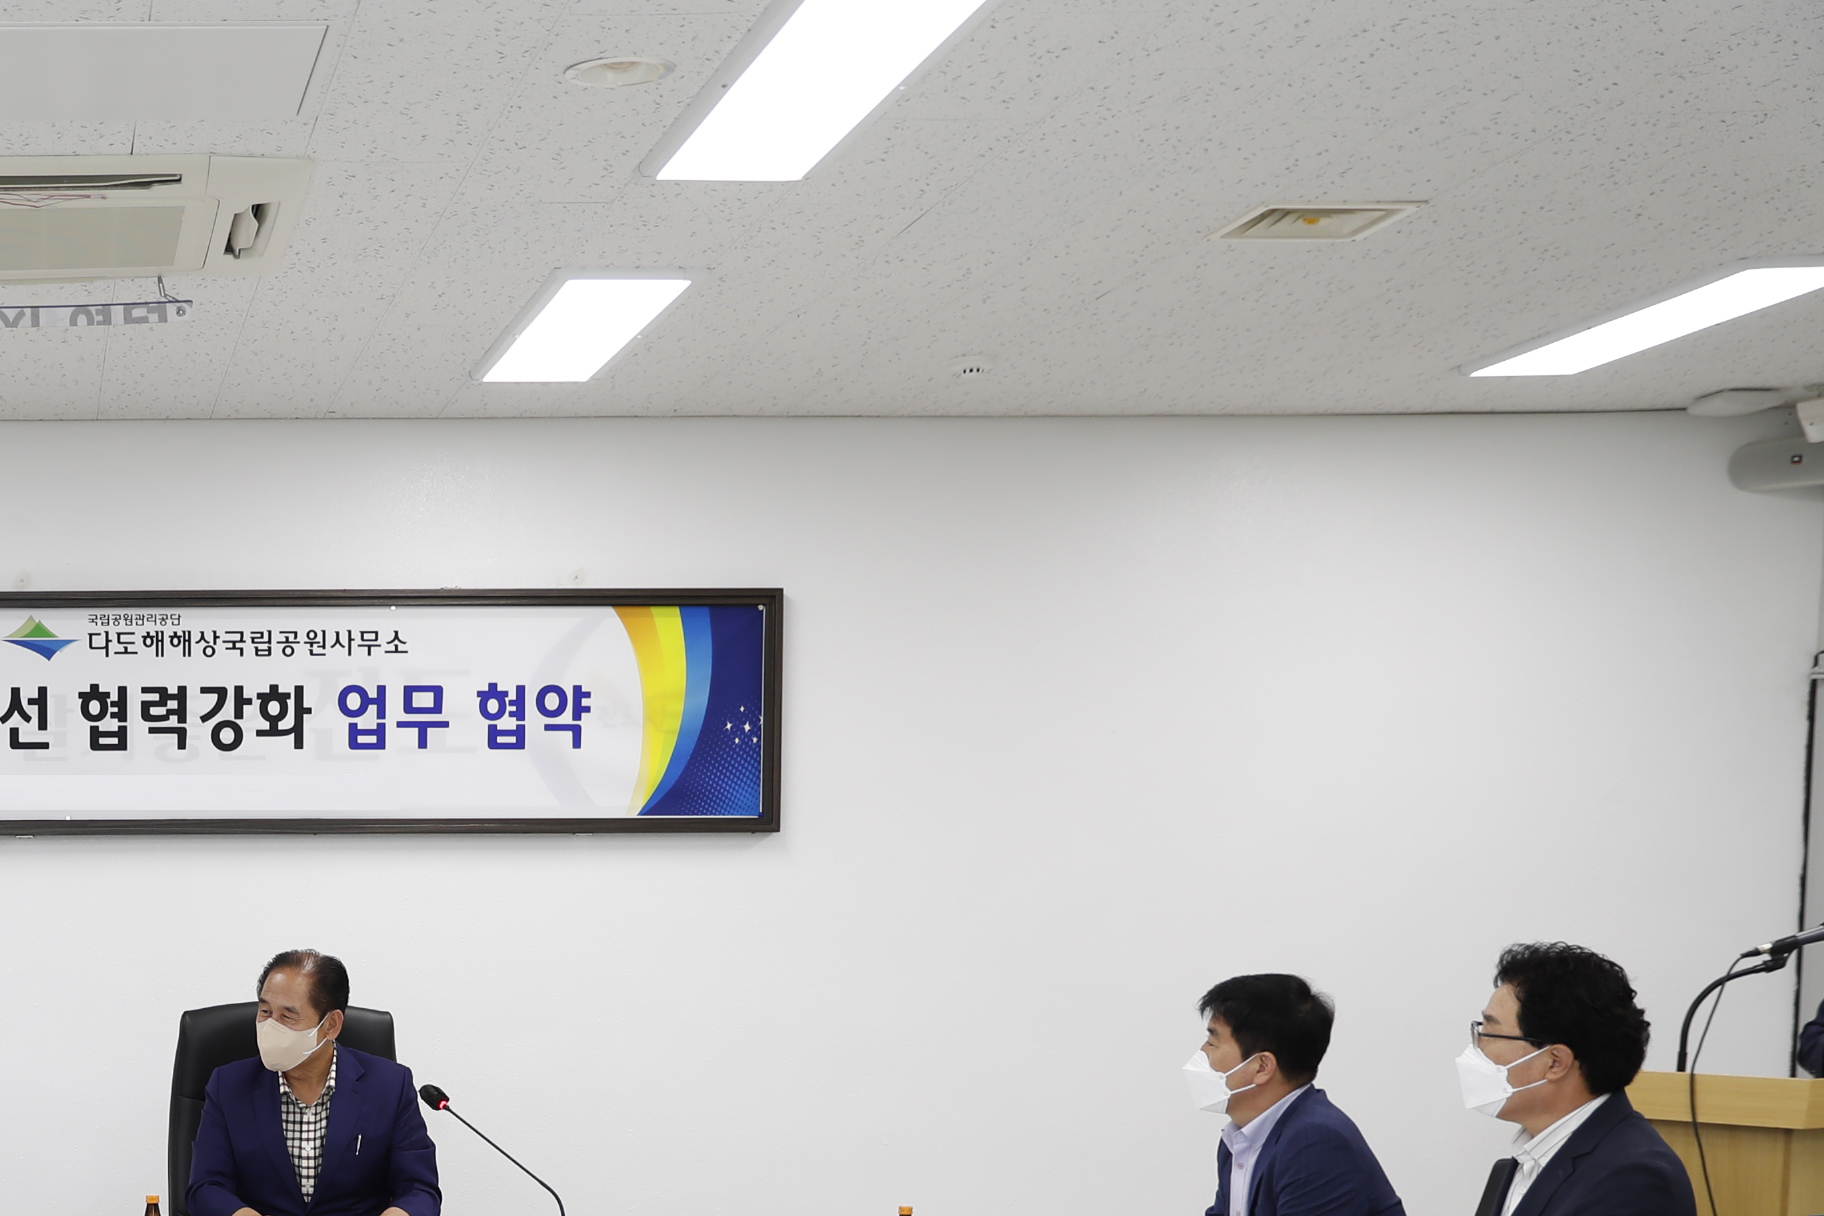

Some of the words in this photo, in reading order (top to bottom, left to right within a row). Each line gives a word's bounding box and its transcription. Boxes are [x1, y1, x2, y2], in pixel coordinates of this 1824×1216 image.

[87, 613, 182, 627] 국립공원관리공단
[87, 629, 409, 658] 다도해해상국립공원사무소
[77, 683, 313, 752] 협력강화
[337, 684, 450, 751] 업무
[476, 682, 592, 750] 협약
